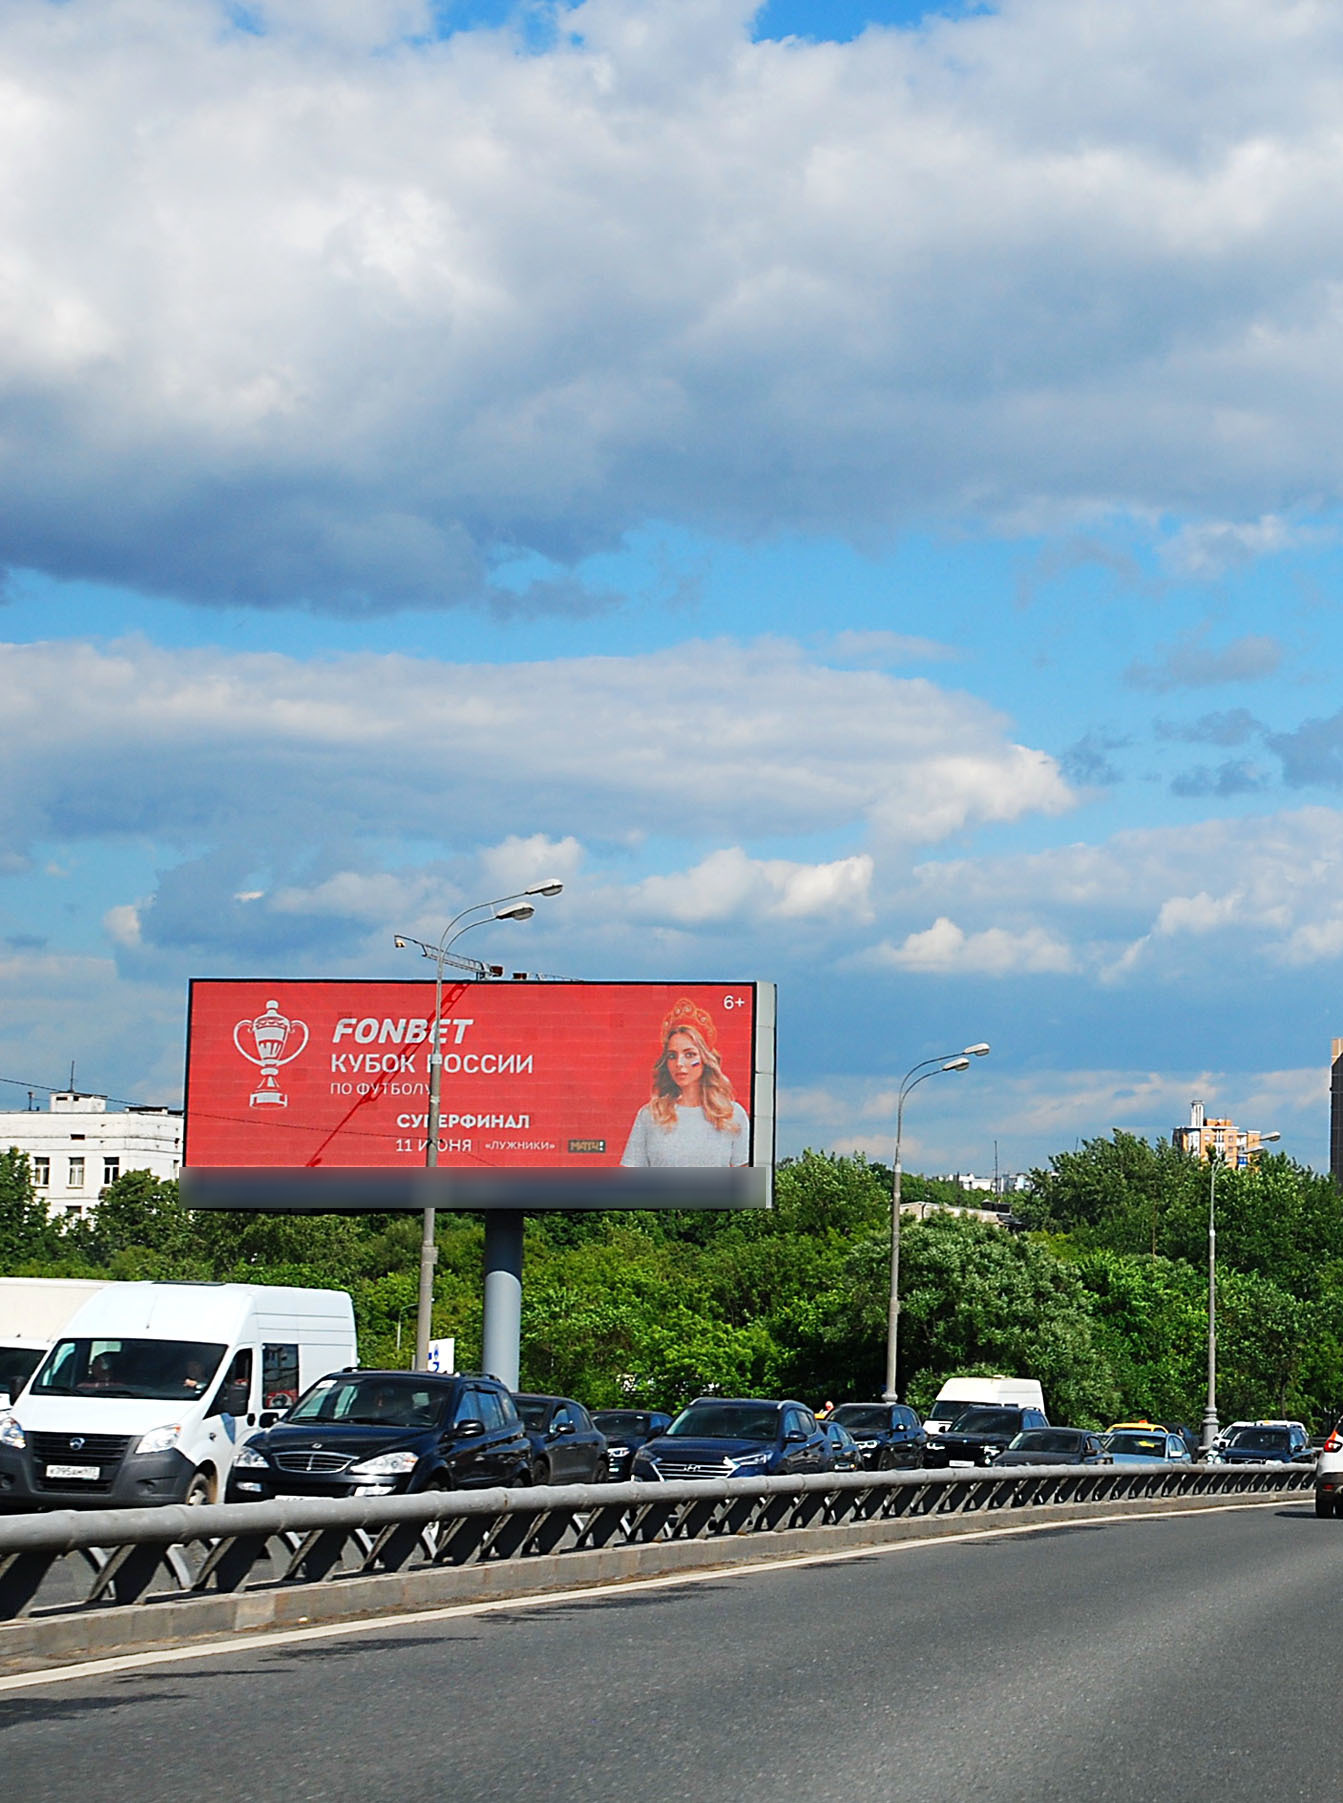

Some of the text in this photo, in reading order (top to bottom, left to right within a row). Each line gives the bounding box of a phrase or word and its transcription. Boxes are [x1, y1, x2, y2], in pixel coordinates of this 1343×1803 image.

[724, 995, 745, 1010] 6+
[332, 1018, 474, 1044] FONBET
[331, 1054, 416, 1074] КУБОК
[331, 1083, 353, 1095] ПО
[396, 1139, 413, 1152] 11
[485, 1140, 556, 1151] «ЛУЖНИКИ»
